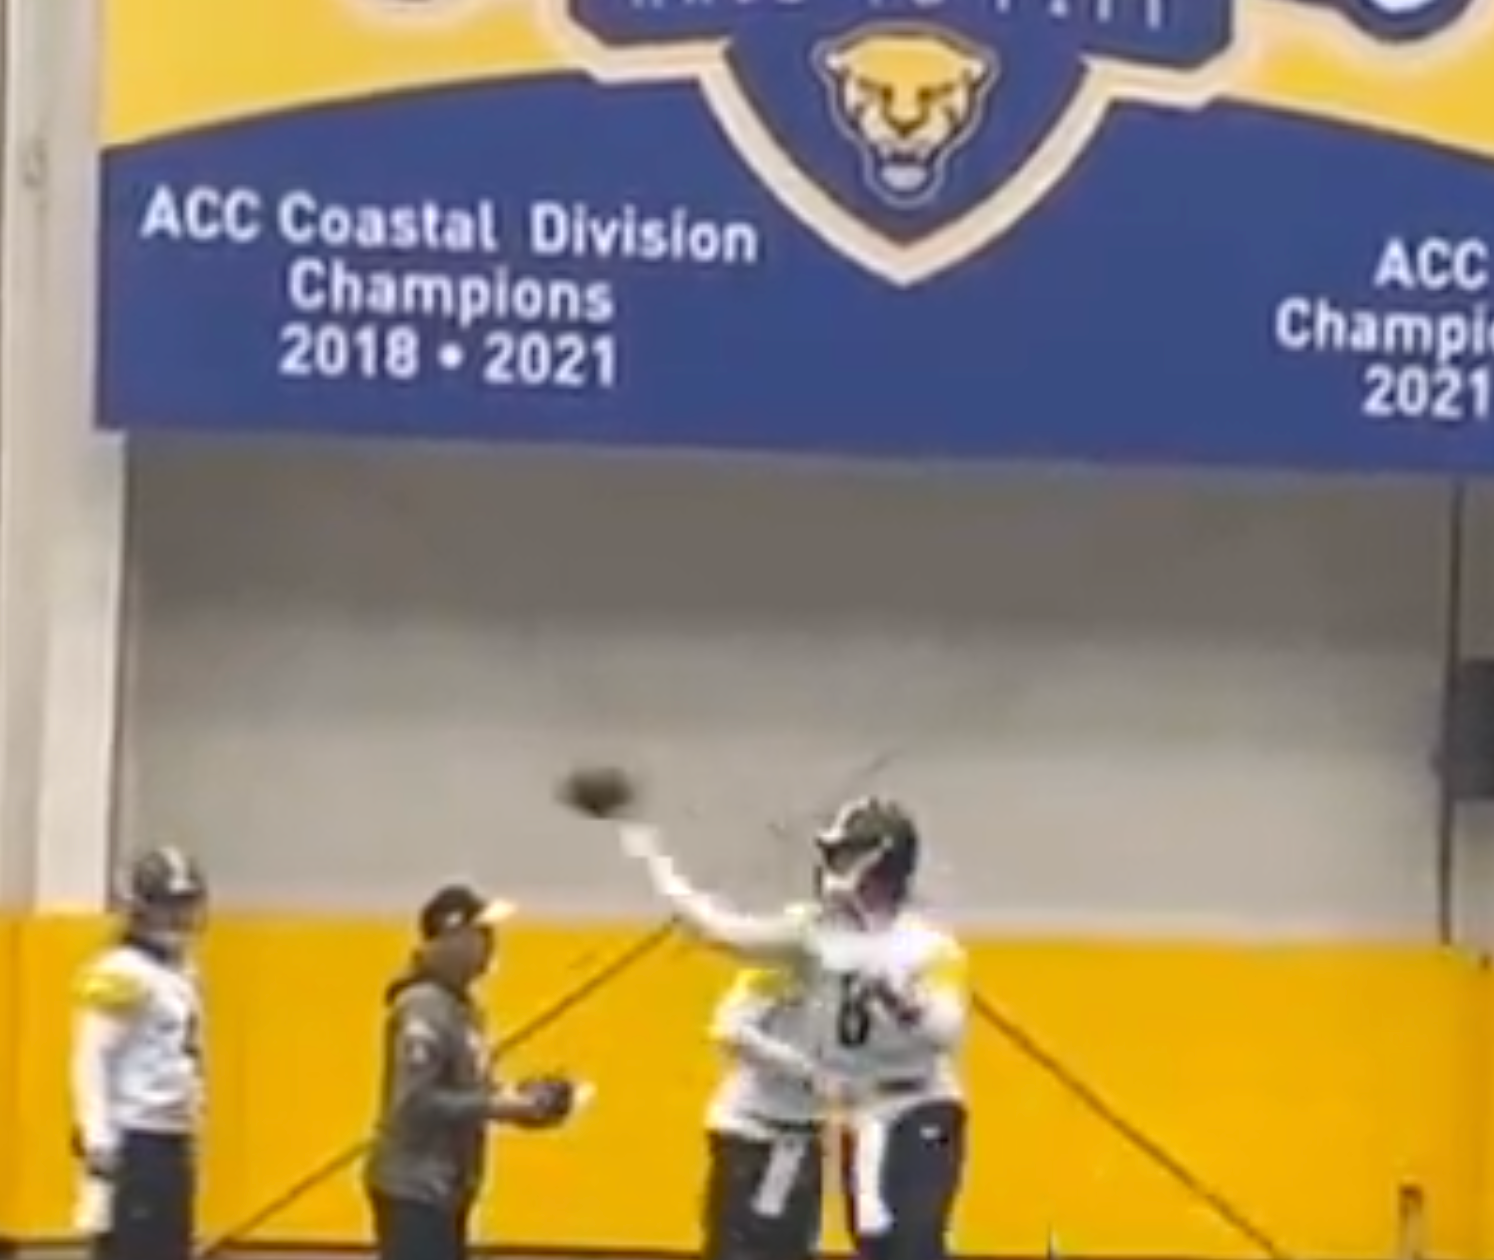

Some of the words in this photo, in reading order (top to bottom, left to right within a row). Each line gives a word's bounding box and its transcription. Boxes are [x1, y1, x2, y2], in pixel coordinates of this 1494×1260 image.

[140, 184, 262, 243] ACC
[277, 190, 498, 253] Coastal
[530, 201, 758, 263] Division
[287, 259, 615, 328] Champions
[1373, 237, 1490, 292] ACC
[279, 322, 420, 379] 2018
[483, 332, 615, 387] 2021
[1362, 363, 1491, 419] 2021
